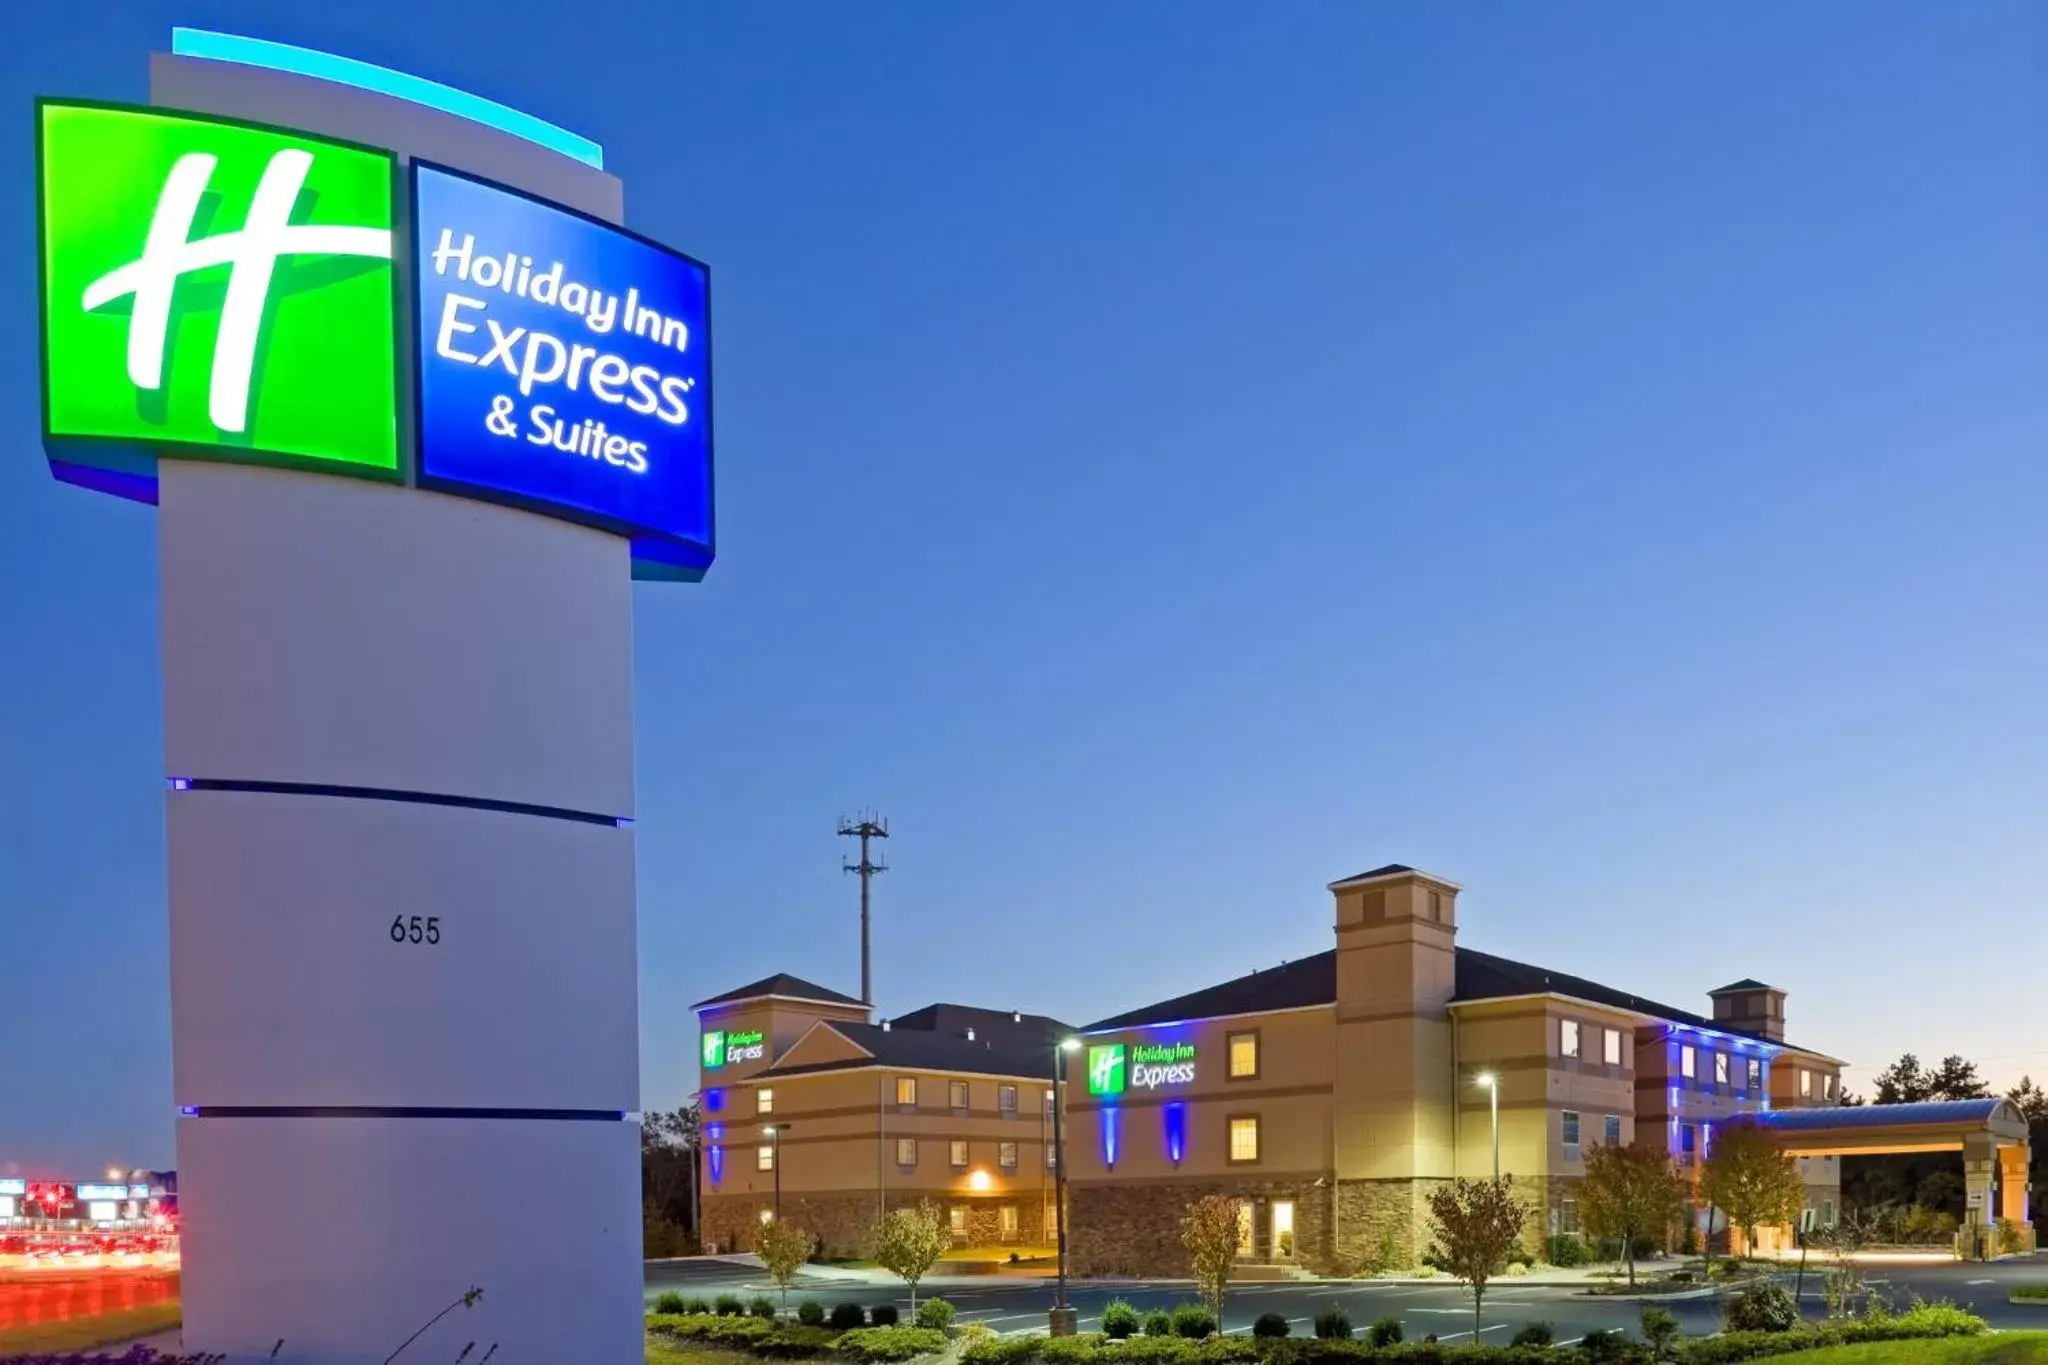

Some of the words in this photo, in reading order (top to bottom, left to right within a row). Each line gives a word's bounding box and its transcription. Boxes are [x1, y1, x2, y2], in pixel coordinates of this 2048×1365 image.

[81, 148, 392, 432] H
[432, 228, 617, 333] Holiday
[623, 287, 688, 352] Inn
[436, 292, 690, 426] Express
[485, 394, 517, 438] &
[527, 404, 649, 473] Suites
[391, 914, 440, 944] 655
[1132, 1044, 1175, 1063] Holiday
[1176, 1041, 1195, 1058] Inn
[1132, 1062, 1195, 1089] Express
